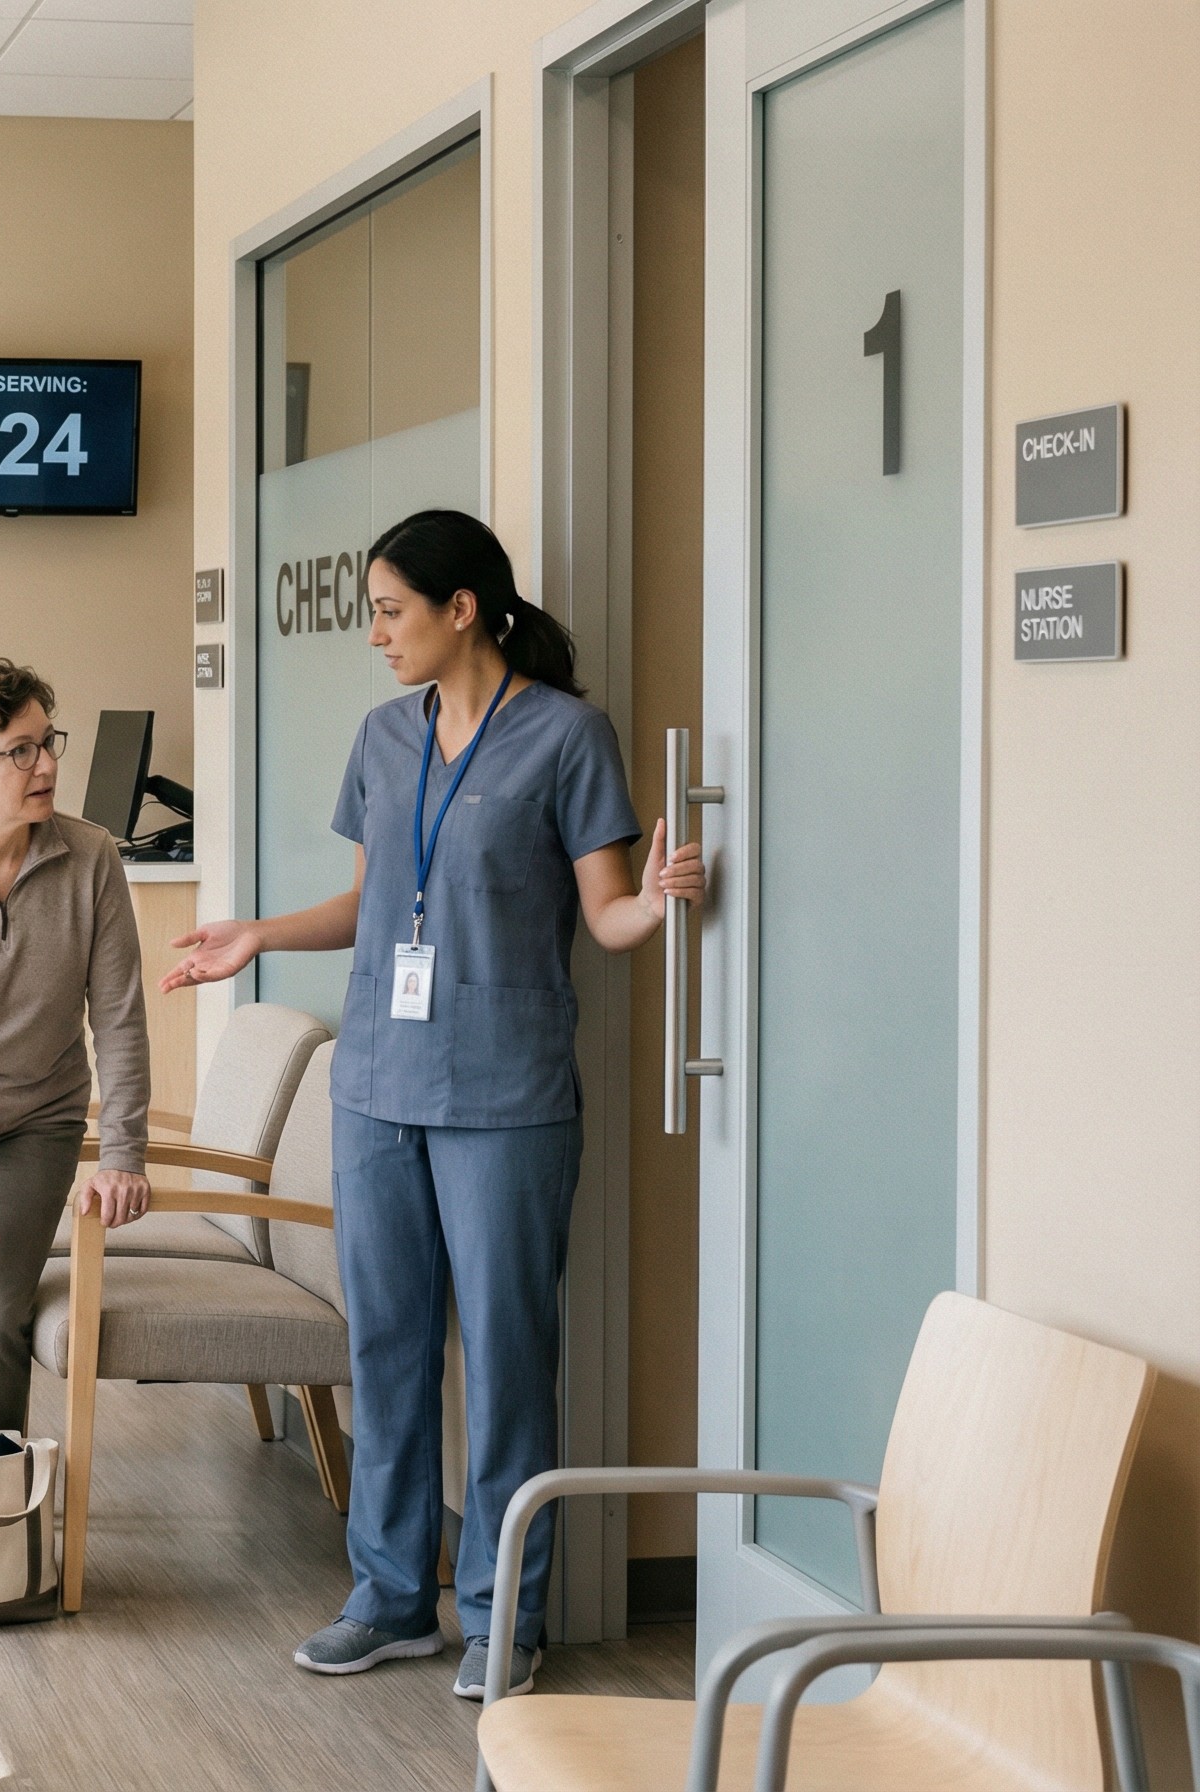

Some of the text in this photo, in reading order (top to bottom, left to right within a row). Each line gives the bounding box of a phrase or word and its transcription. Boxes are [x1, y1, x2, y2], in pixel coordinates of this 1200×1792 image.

[863, 289, 901, 476] 1
[1022, 427, 1095, 461] CHECK-IN
[276, 550, 373, 636] CHECK
[1021, 585, 1073, 611] NURSE
[1021, 615, 1083, 641] STATION
